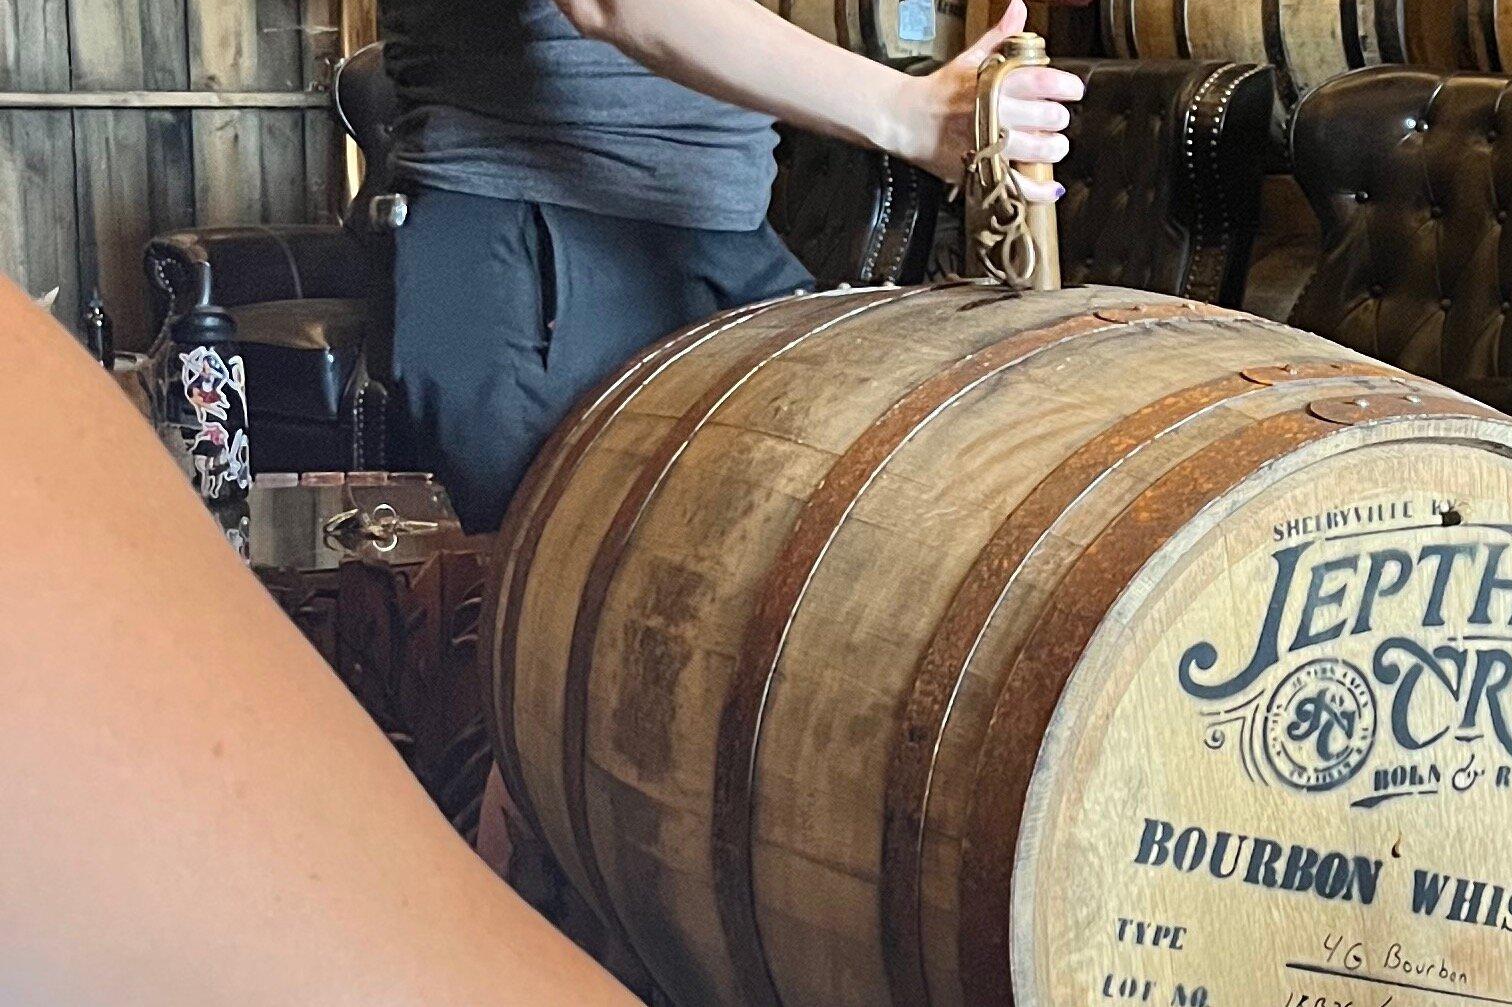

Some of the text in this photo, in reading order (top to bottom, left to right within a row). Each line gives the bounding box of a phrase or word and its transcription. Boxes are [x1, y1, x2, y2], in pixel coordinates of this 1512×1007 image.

[1272, 500, 1414, 542] SHELBYVILLE
[1374, 763, 1441, 792] BORN
[1134, 818, 1384, 906] BOURBON
[1116, 916, 1188, 951] TYPE
[1383, 943, 1468, 985] Bourbon
[1102, 973, 1157, 1002] LOT
